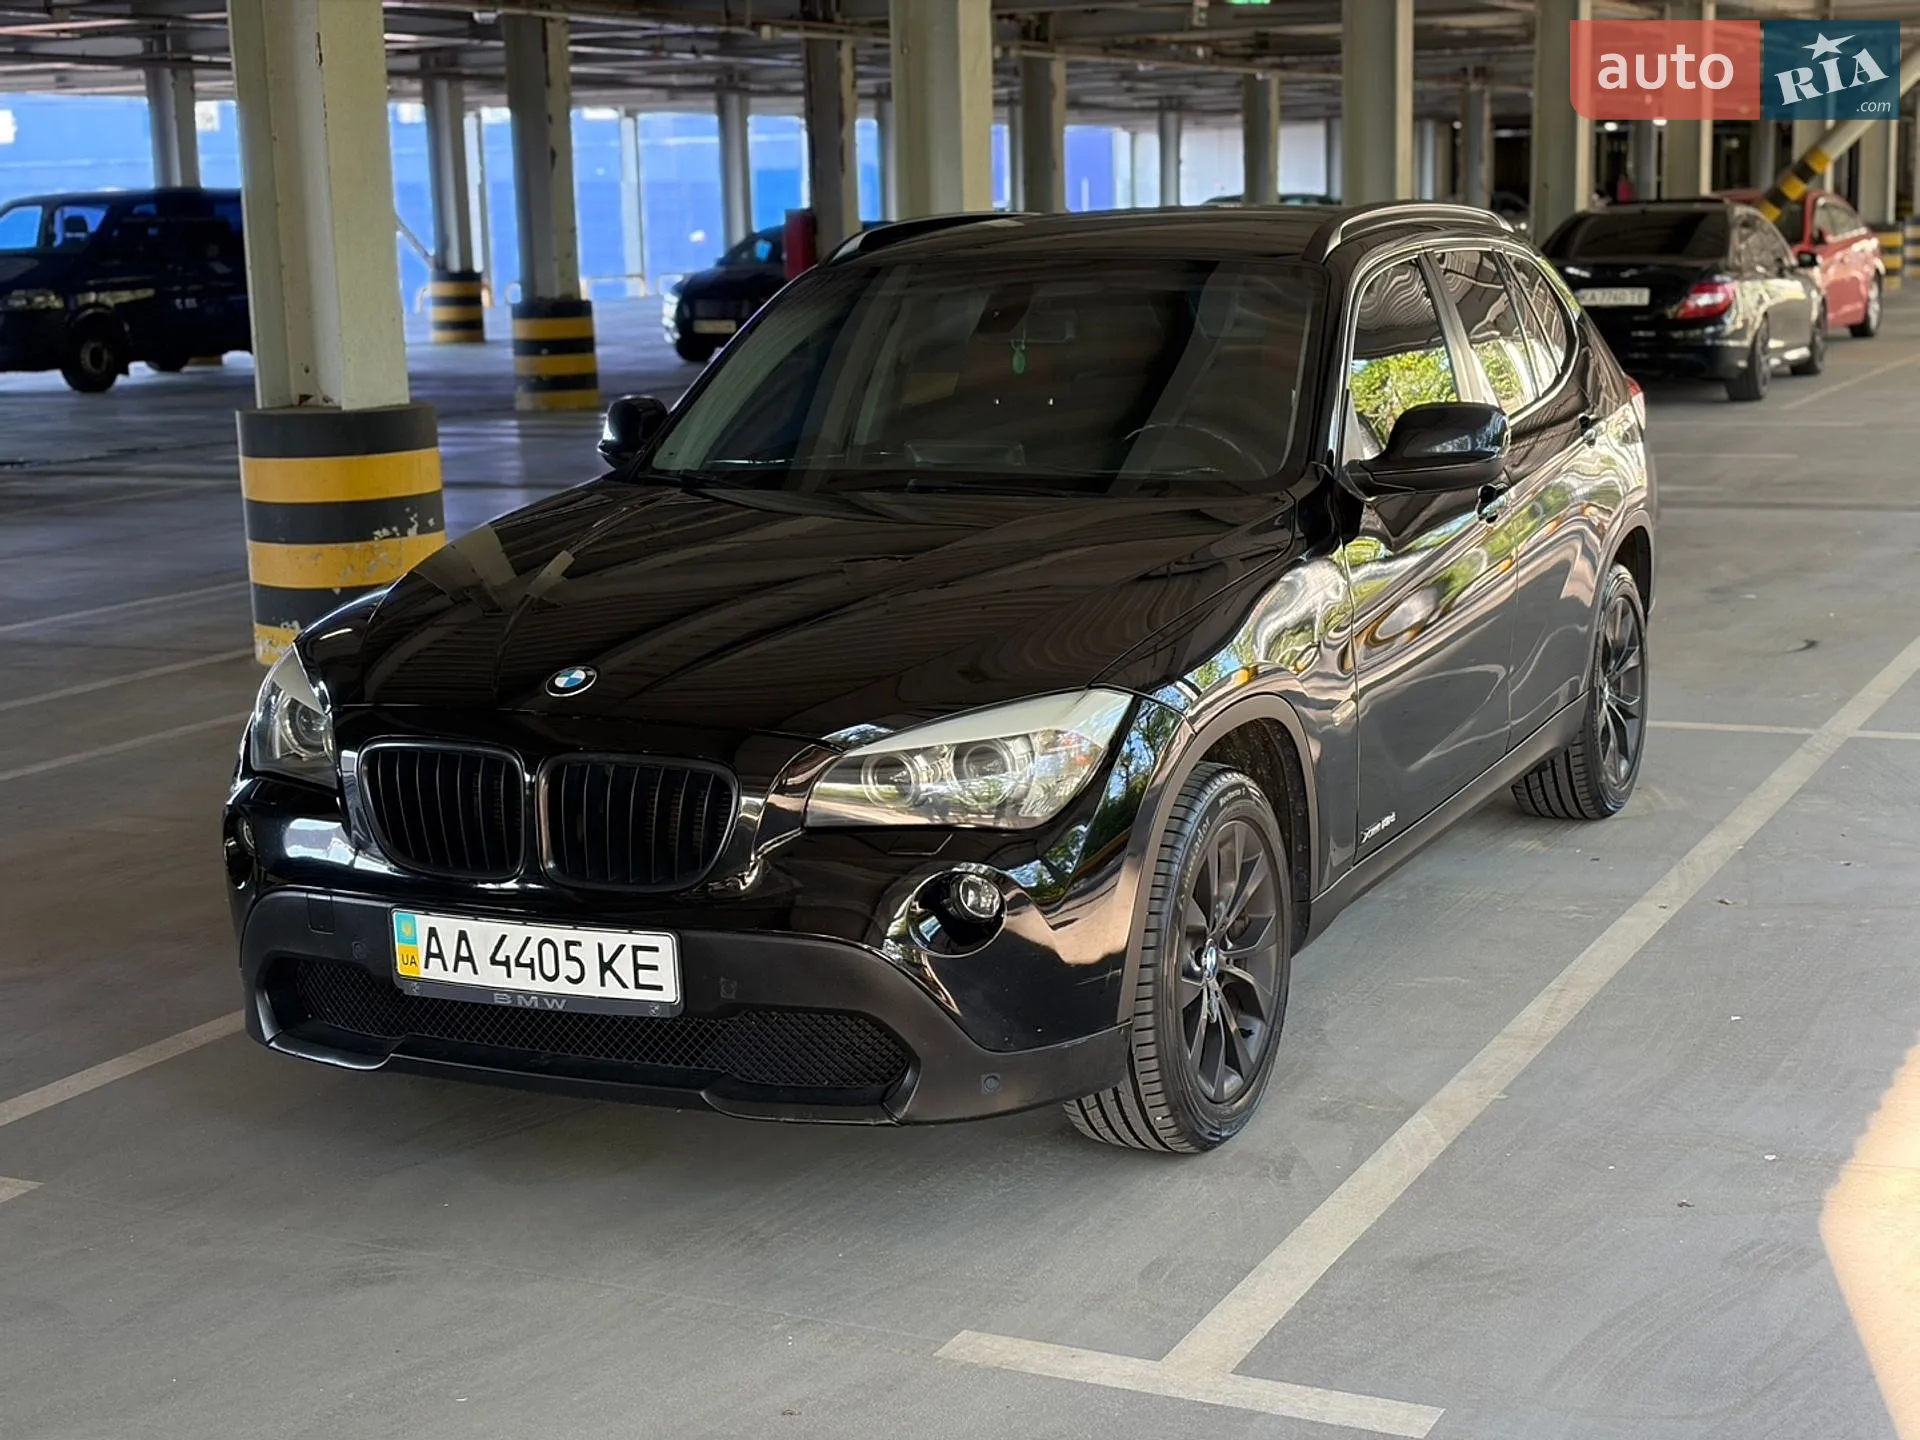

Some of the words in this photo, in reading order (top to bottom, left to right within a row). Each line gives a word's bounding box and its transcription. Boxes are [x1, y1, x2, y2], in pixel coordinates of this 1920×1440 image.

[401, 953, 418, 968] UA
[424, 926, 479, 976] AA
[489, 934, 585, 985] 4405
[597, 942, 664, 992] KE
[492, 993, 567, 1010] BMW
